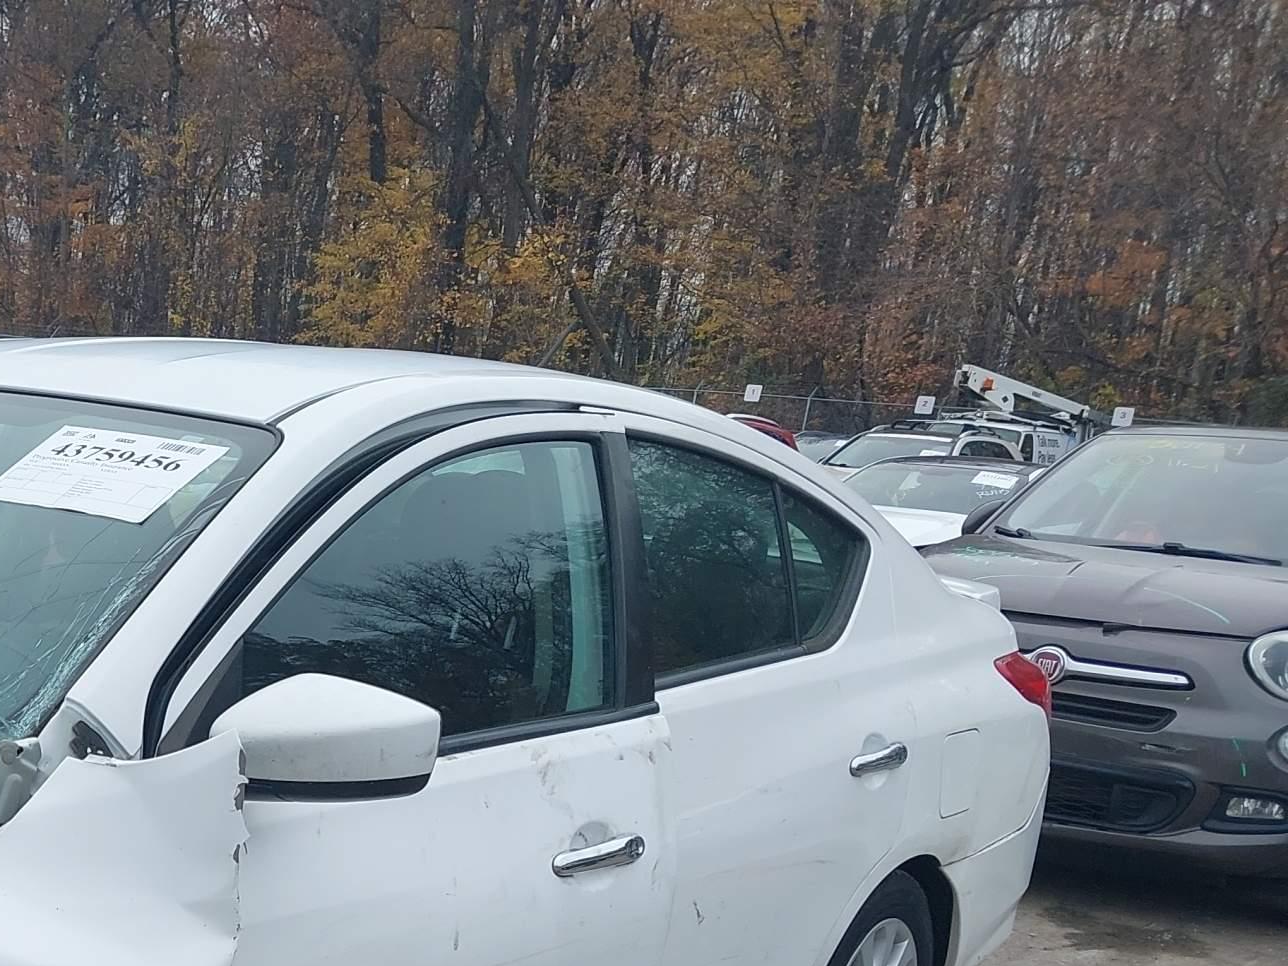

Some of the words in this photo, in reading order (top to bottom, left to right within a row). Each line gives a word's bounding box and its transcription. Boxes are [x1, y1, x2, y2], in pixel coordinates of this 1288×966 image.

[1120, 411, 1127, 419] 3
[51, 442, 186, 472] 43759456
[1038, 658, 1058, 674] FIAT
